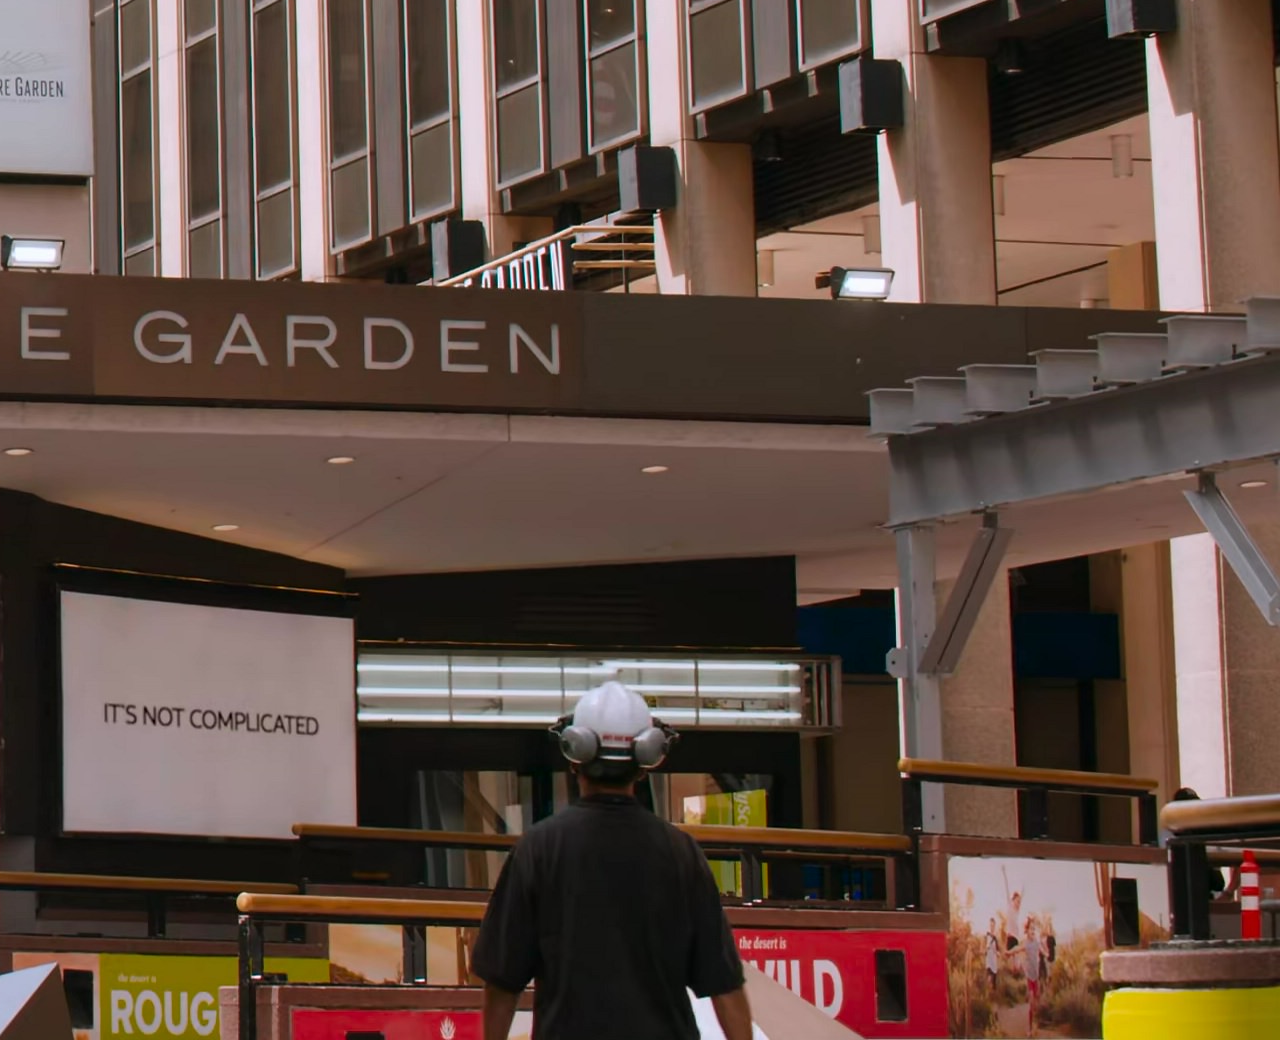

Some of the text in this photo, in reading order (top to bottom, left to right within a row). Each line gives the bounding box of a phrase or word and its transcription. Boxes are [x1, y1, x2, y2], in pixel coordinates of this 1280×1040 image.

[15, 76, 64, 98] GARDEN
[132, 309, 561, 375] GARDEN
[103, 703, 320, 736] IT'S NOT COMPLICATED
[739, 936, 787, 950] the desert is
[110, 989, 218, 1036] ROUG
